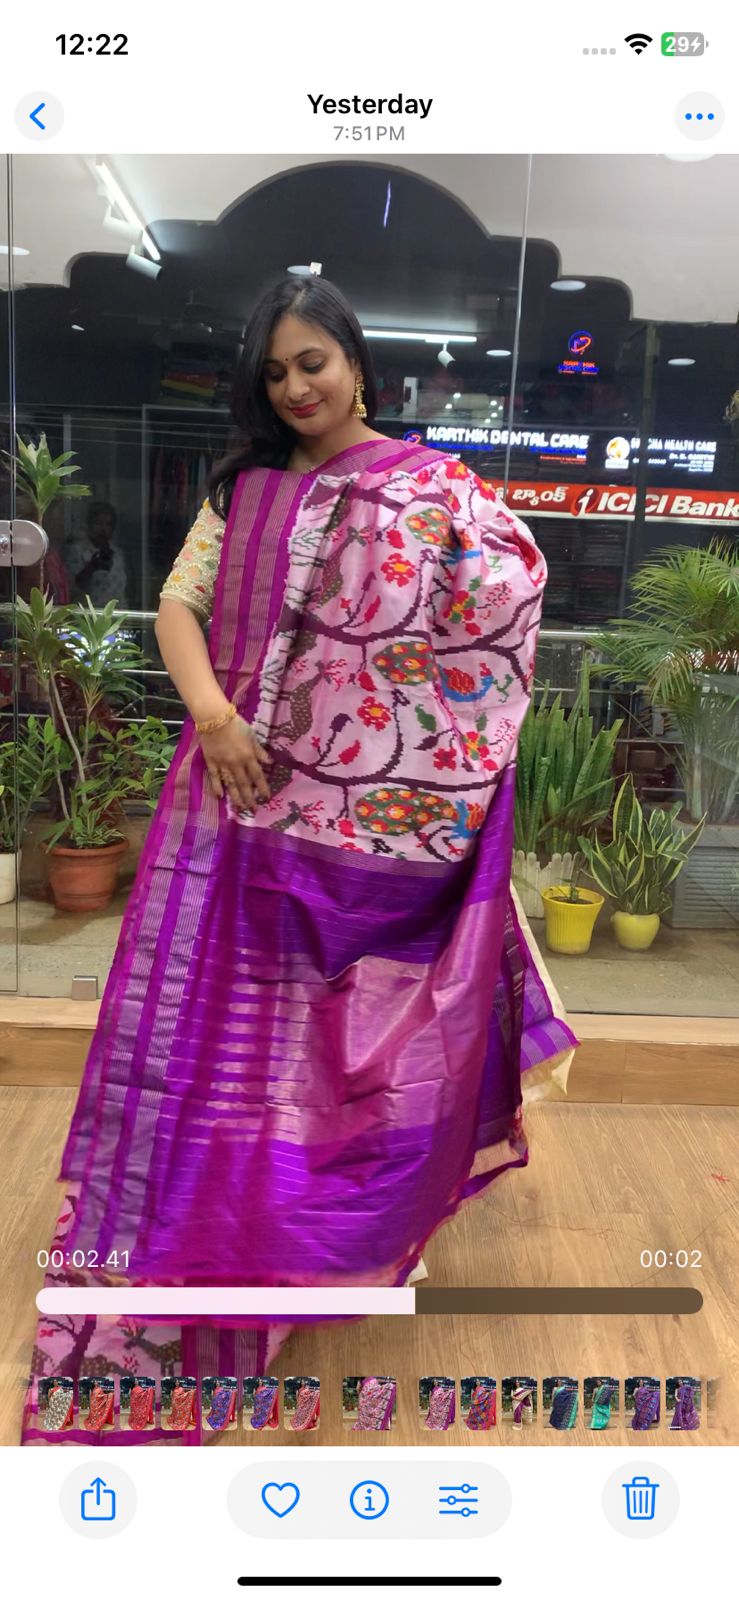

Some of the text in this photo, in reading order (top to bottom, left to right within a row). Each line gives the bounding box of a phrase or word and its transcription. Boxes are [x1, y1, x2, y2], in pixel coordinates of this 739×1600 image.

[426, 426, 590, 449] KARTHIK DENTAL CARE
[664, 439, 694, 452] HEALTH
[695, 441, 717, 453] CARE
[597, 491, 668, 514] ICICI
[670, 496, 739, 517] Bank
